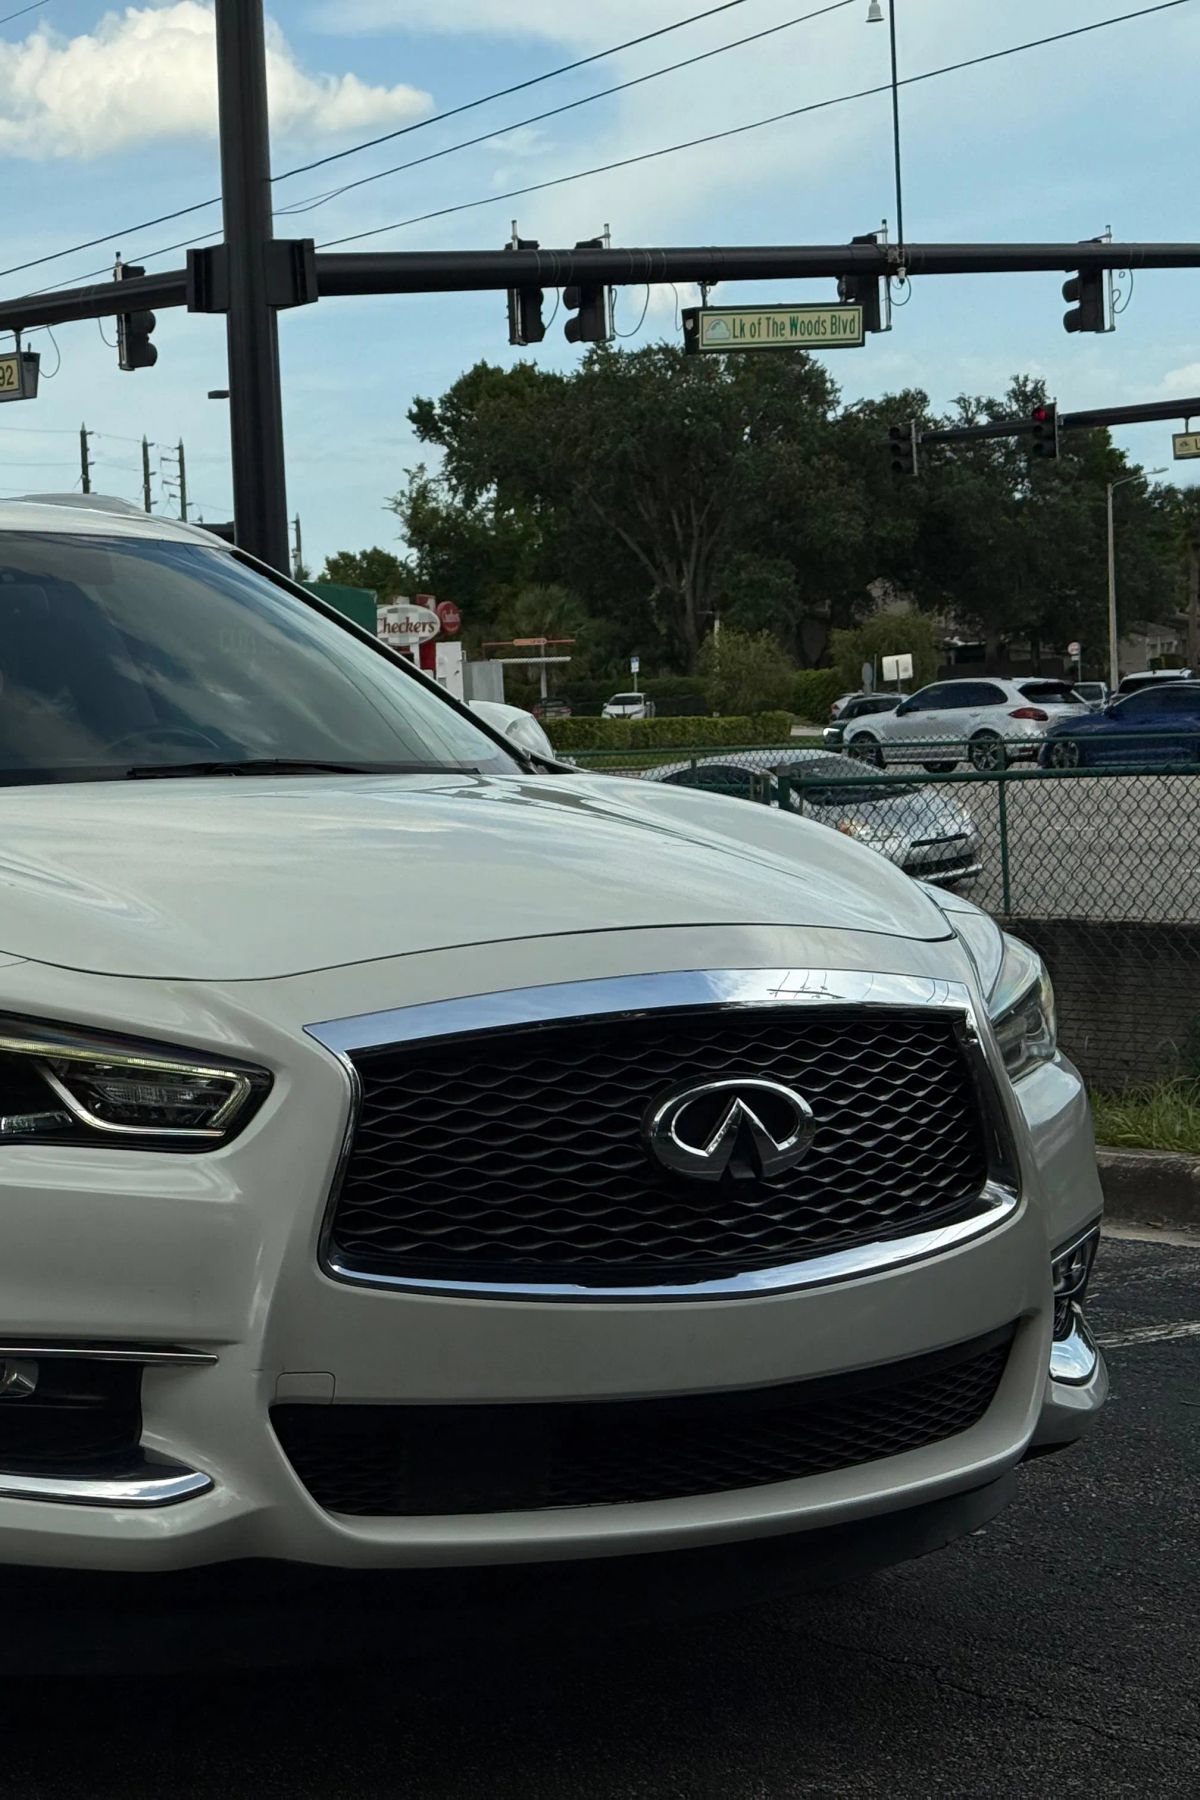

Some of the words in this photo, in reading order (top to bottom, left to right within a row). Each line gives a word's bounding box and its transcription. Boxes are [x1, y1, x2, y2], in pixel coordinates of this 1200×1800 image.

[732, 317, 746, 339] Lk
[749, 317, 761, 338] of
[765, 317, 785, 337] The
[789, 315, 827, 337] Woods
[830, 314, 856, 335] Blvd
